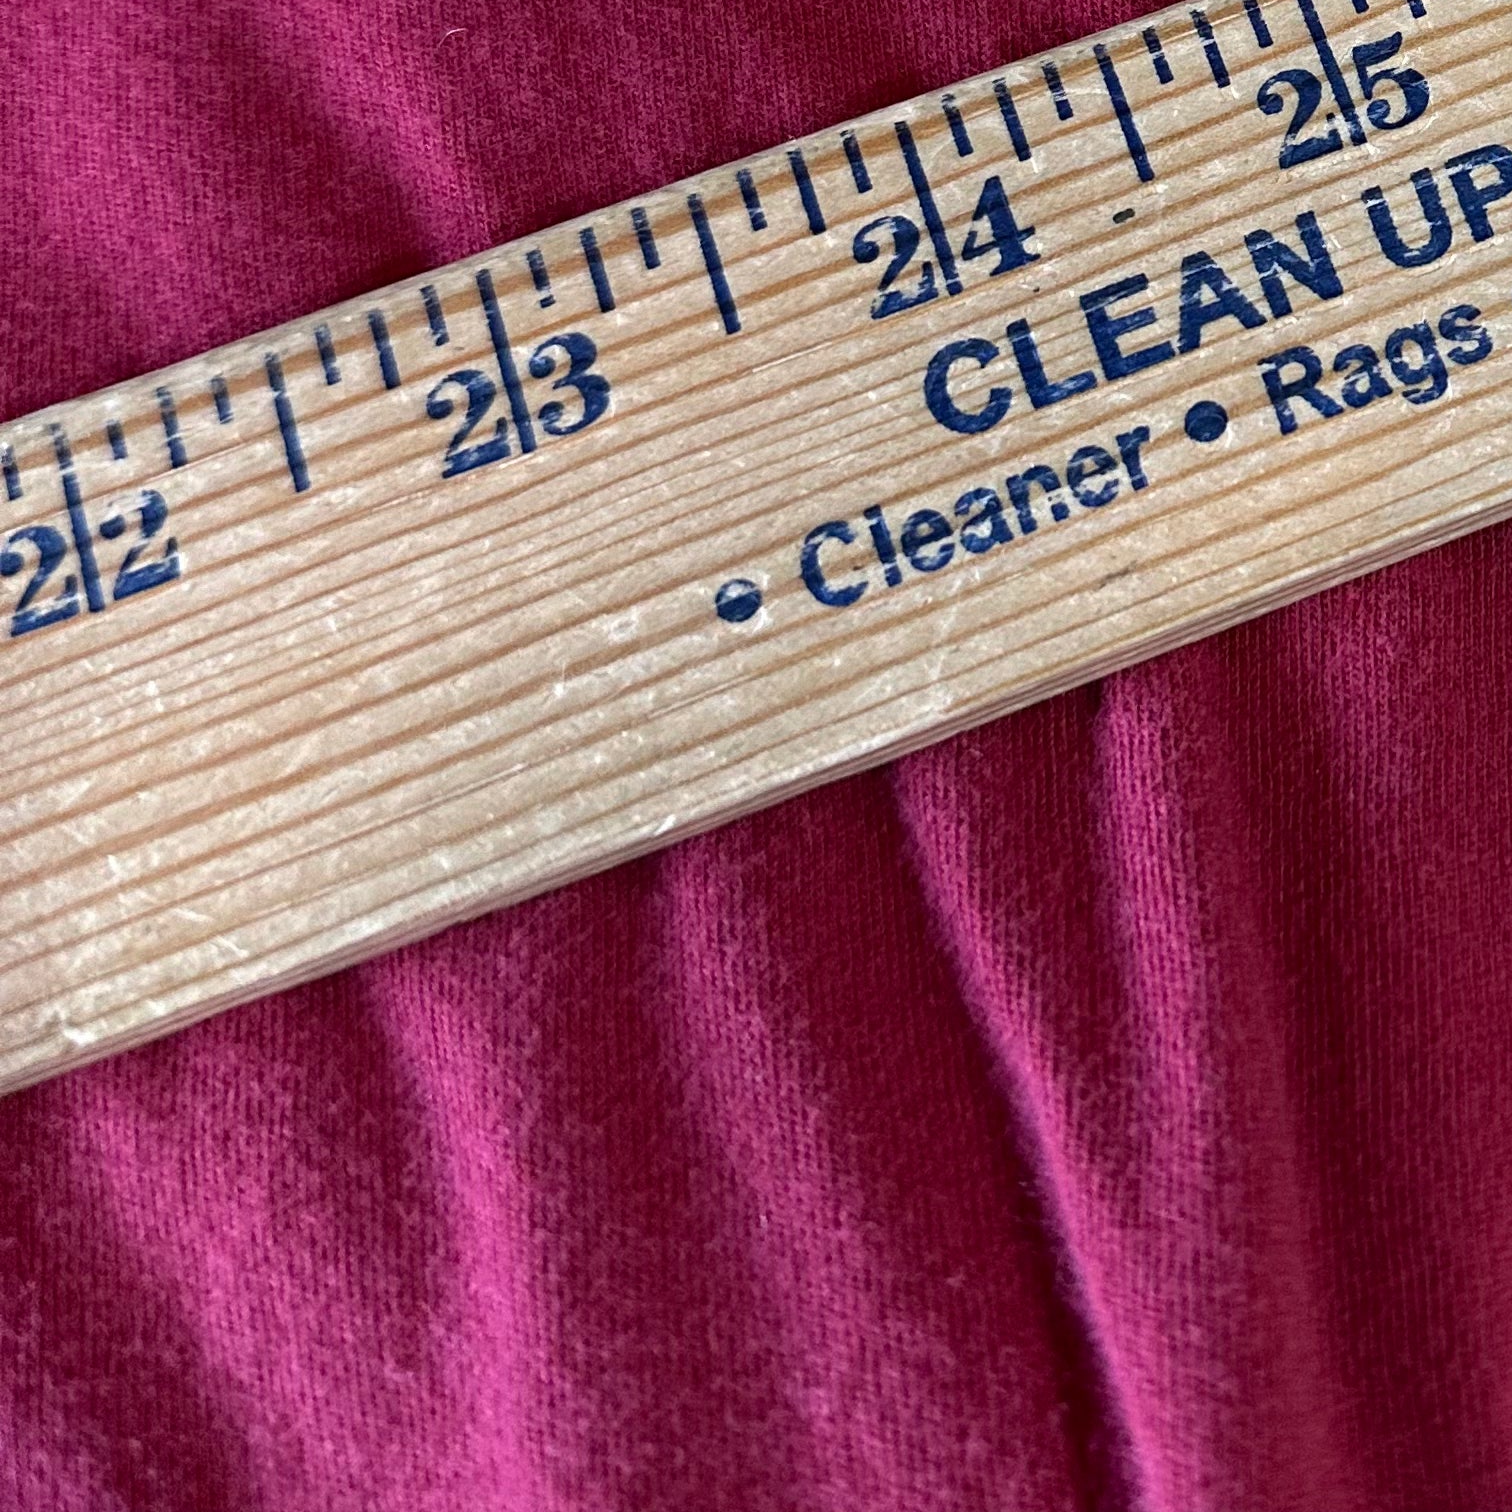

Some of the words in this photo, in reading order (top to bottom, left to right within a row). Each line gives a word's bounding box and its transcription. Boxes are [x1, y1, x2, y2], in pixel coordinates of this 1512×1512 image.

[0, 489, 180, 636] 22
[427, 332, 611, 478] 23
[853, 175, 1041, 319] 24
[1257, 31, 1430, 169] 25
[800, 425, 1152, 607] Cleaner
[1257, 304, 1493, 435] Rags
[923, 210, 1343, 434] CLEAN
